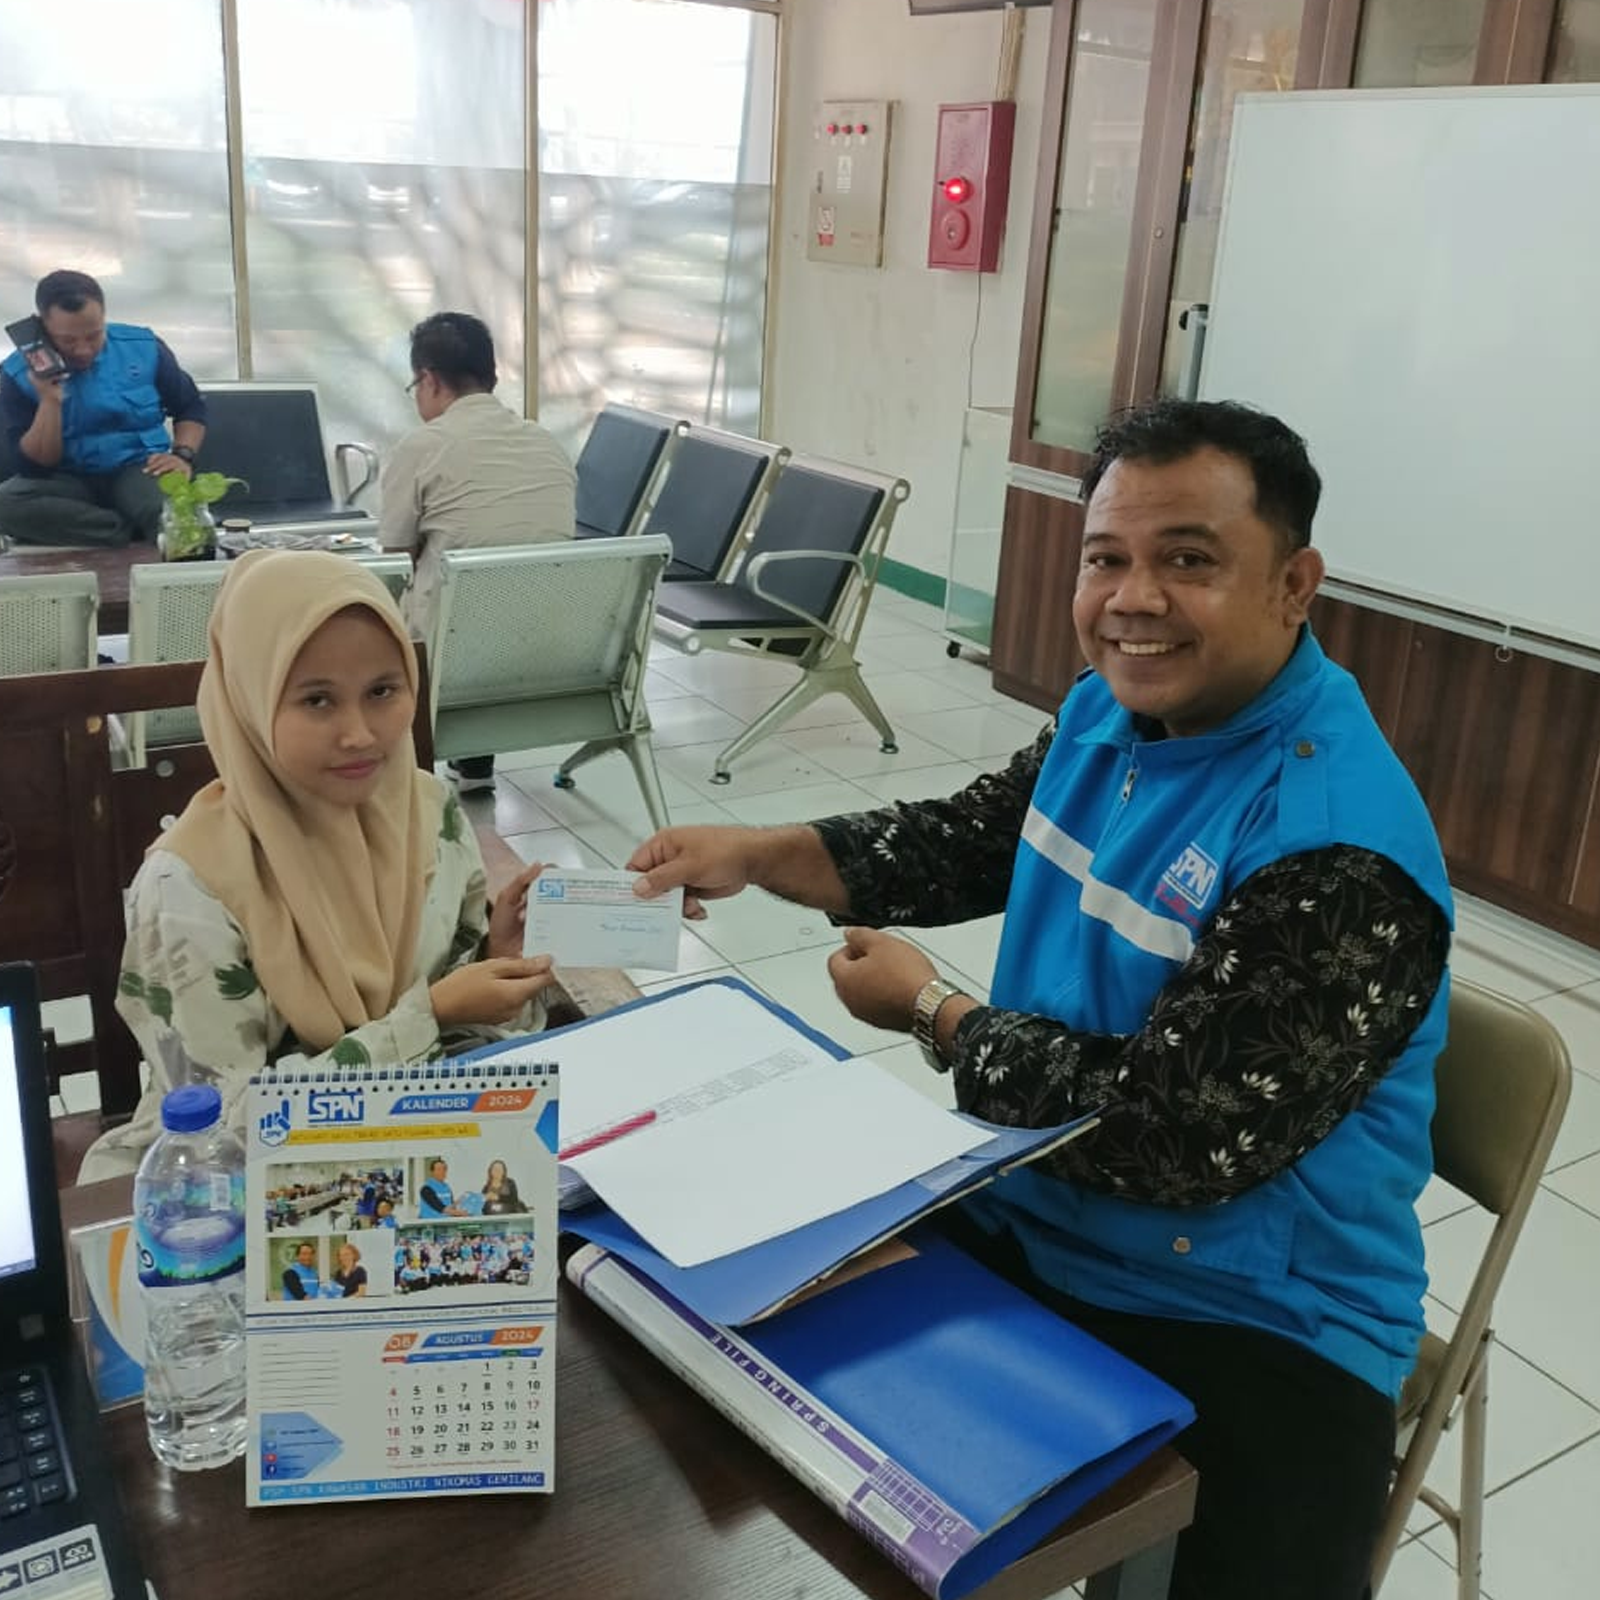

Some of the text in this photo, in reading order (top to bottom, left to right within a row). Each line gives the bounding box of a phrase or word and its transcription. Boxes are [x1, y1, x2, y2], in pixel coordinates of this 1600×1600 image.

[308, 1092, 363, 1121] SPN
[402, 1095, 522, 1110] KALENDER 2024
[435, 1333, 483, 1345] AGUSTUS
[502, 1330, 534, 1341] 2024
[485, 1362, 490, 1370] 1
[531, 1360, 537, 1369] 3
[413, 1385, 421, 1395] 5
[461, 1383, 467, 1391] 7
[484, 1382, 491, 1390] 8
[528, 1380, 540, 1390] 10
[711, 1333, 829, 1433] SPRING FILE
[387, 1407, 399, 1417] 11
[411, 1406, 424, 1415] 12
[435, 1404, 447, 1413] 13
[458, 1402, 470, 1411] 14
[481, 1401, 494, 1411] 15
[505, 1400, 516, 1410] 16
[411, 1425, 424, 1434] 19
[434, 1424, 448, 1433] 20
[457, 1423, 469, 1432] 21
[481, 1422, 494, 1431] 22
[503, 1420, 516, 1430] 23
[526, 1420, 540, 1429] 24
[433, 1444, 447, 1453] 27
[457, 1442, 470, 1452] 28
[481, 1441, 494, 1451] 29
[503, 1440, 516, 1450] 30
[526, 1440, 539, 1449] 31
[374, 1479, 428, 1491] INDUSTRI
[434, 1476, 483, 1488] NIKOMAS
[488, 1473, 542, 1486] GEMILANG
